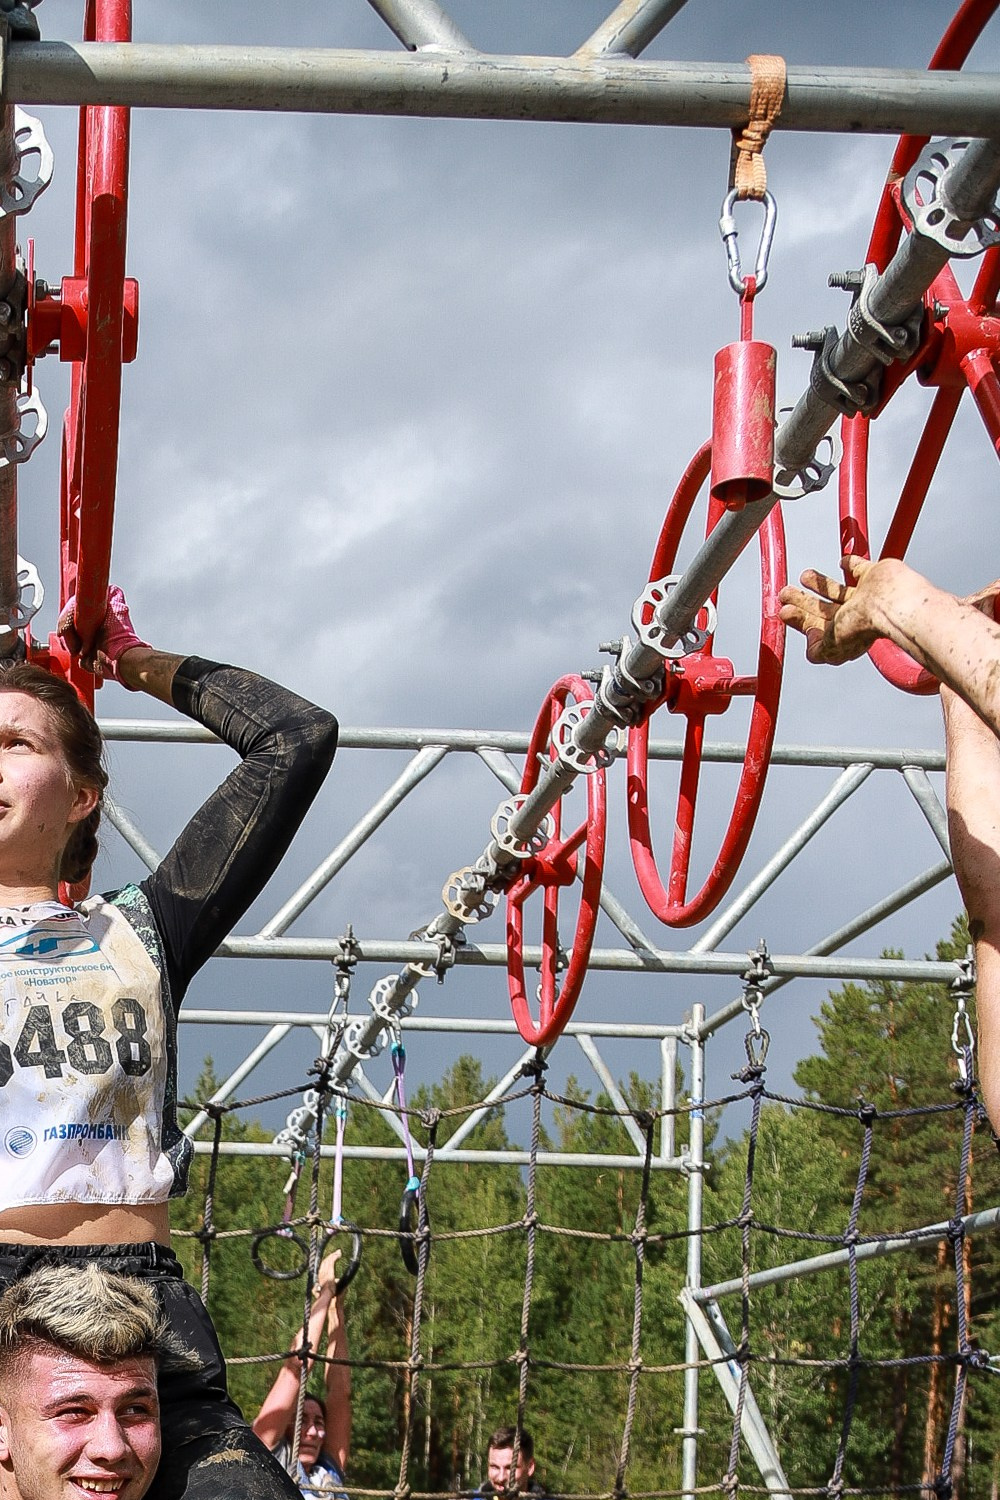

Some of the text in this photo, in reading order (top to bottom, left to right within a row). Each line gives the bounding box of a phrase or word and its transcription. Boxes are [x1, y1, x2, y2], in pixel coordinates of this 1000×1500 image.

[14, 963, 99, 978] конструкторское
[23, 976, 77, 988] «Новатор»
[43, 1122, 131, 1142] ГАЗПРОМБАНК
